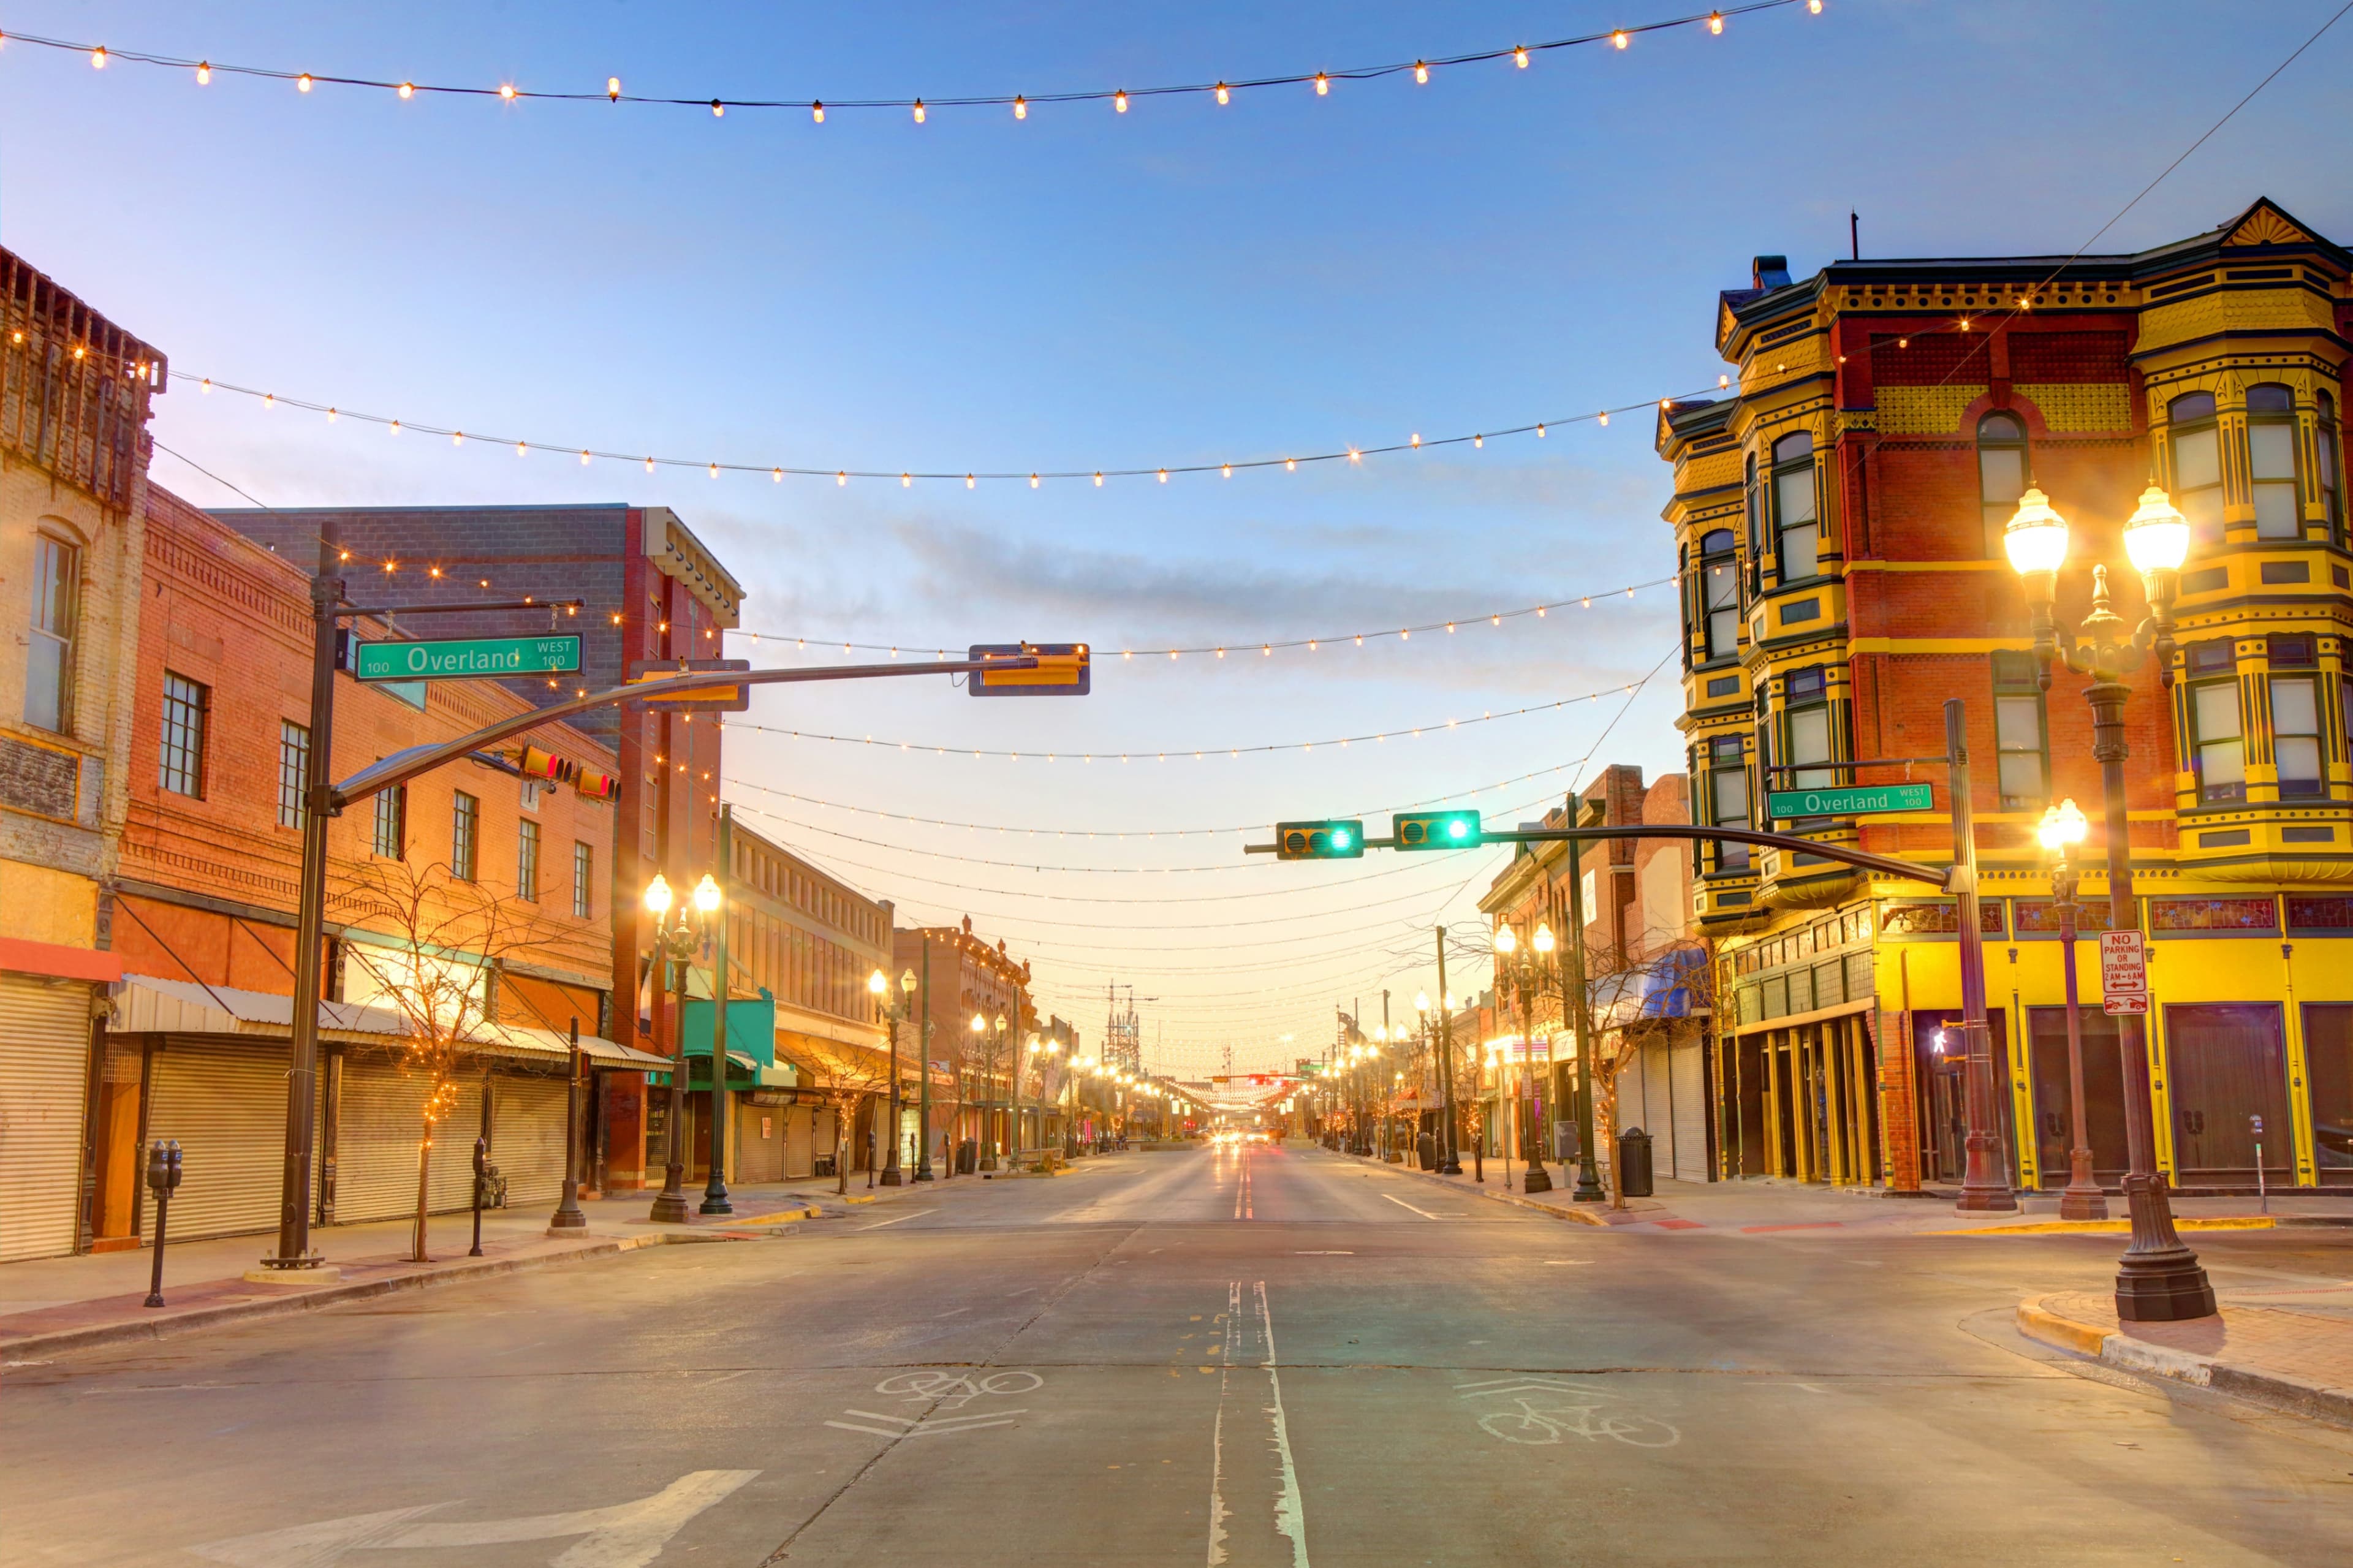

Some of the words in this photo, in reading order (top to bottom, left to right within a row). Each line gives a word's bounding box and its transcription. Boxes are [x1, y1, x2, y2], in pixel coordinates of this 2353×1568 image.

[537, 641, 571, 653] WEST
[407, 647, 519, 671] Overland
[542, 656, 565, 666] 100
[368, 662, 390, 673] 100
[1900, 788, 1924, 797] WEST
[1805, 794, 1888, 812] Overland
[1905, 798, 1922, 806] 100
[1776, 805, 1793, 814] 100
[2112, 935, 2131, 945] NO
[2104, 945, 2139, 954] PARKING
[2105, 963, 2141, 972] STANDING
